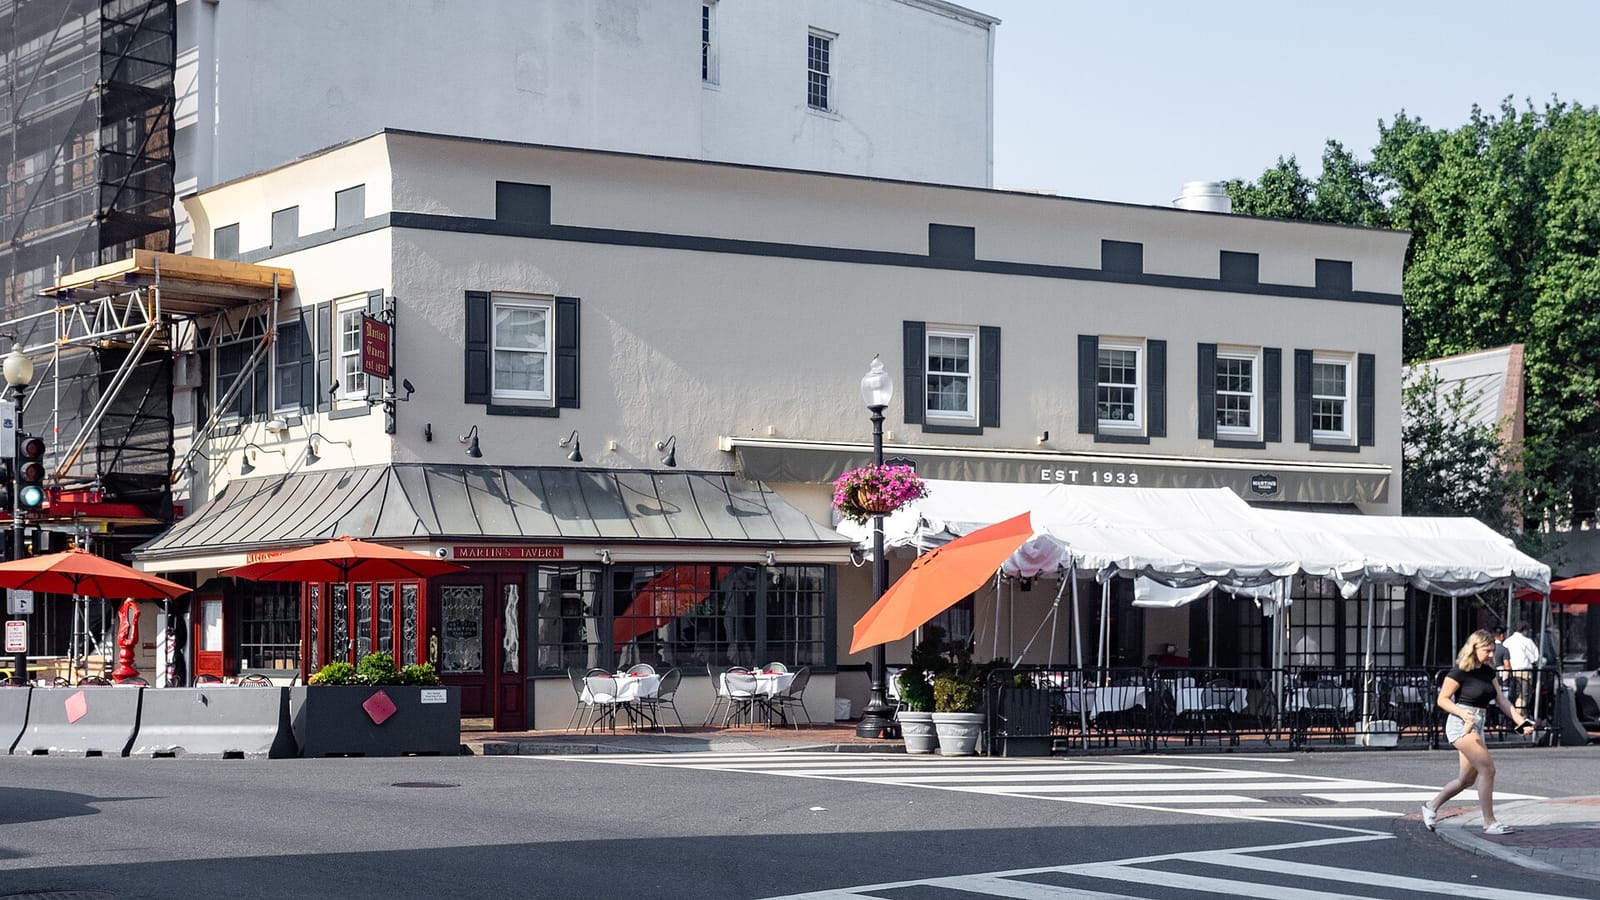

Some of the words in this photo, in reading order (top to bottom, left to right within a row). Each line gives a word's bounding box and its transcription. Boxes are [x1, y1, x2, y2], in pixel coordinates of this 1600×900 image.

[1041, 469, 1079, 482] EST
[1092, 471, 1139, 485] 1933
[459, 547, 511, 558] MARTIN'S
[521, 548, 560, 558] TAVERN
